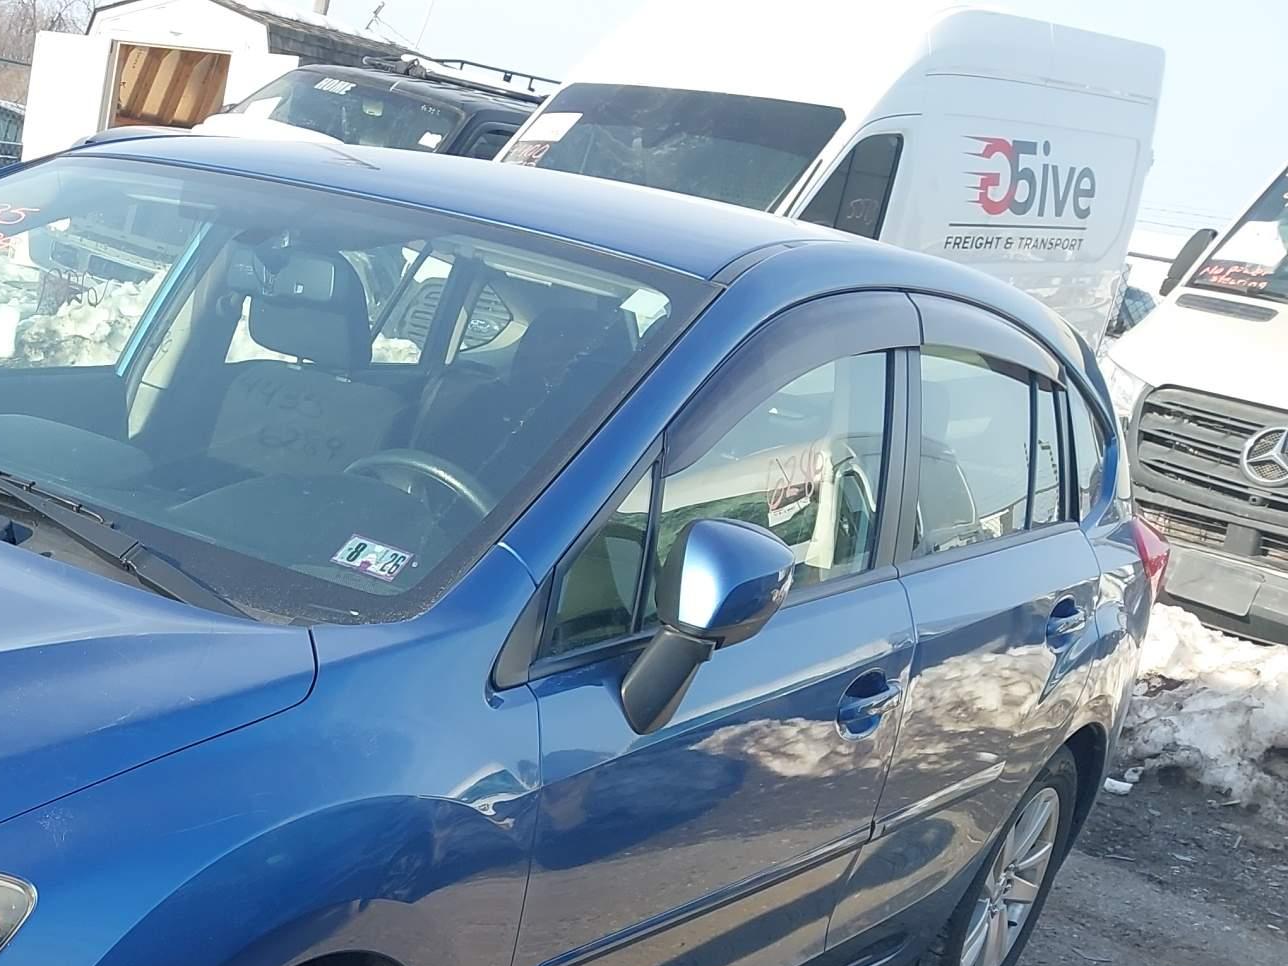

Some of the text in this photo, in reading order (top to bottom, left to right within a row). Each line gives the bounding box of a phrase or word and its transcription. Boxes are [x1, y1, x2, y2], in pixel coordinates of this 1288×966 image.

[314, 77, 358, 95] HOME
[944, 235, 1085, 251] FREIGHT & TRANSPORT
[379, 552, 407, 575] 26
